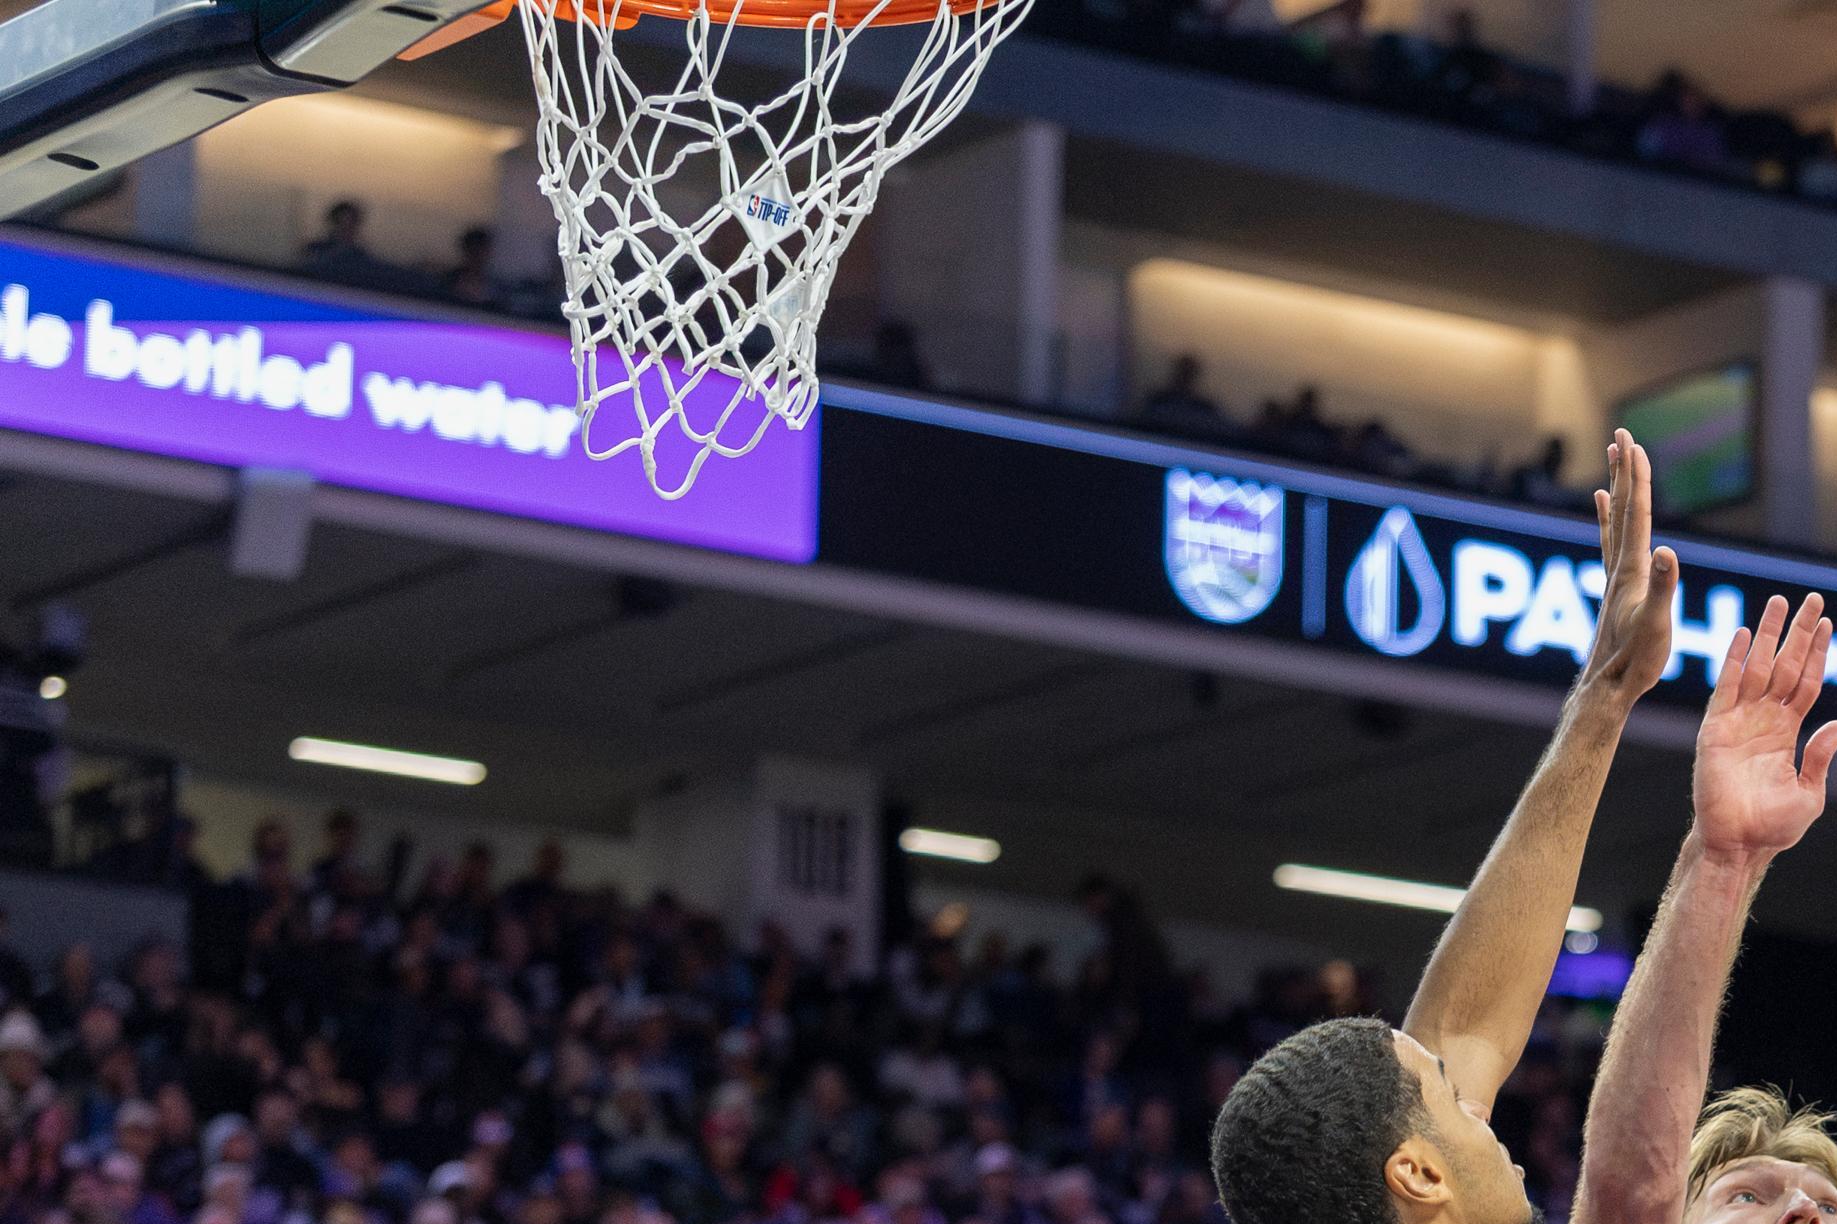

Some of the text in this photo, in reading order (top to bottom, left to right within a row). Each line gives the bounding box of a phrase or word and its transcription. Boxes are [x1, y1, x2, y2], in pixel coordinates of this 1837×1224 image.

[84, 298, 354, 419] bottled
[361, 371, 577, 458] water
[1451, 539, 1744, 688] PAH
